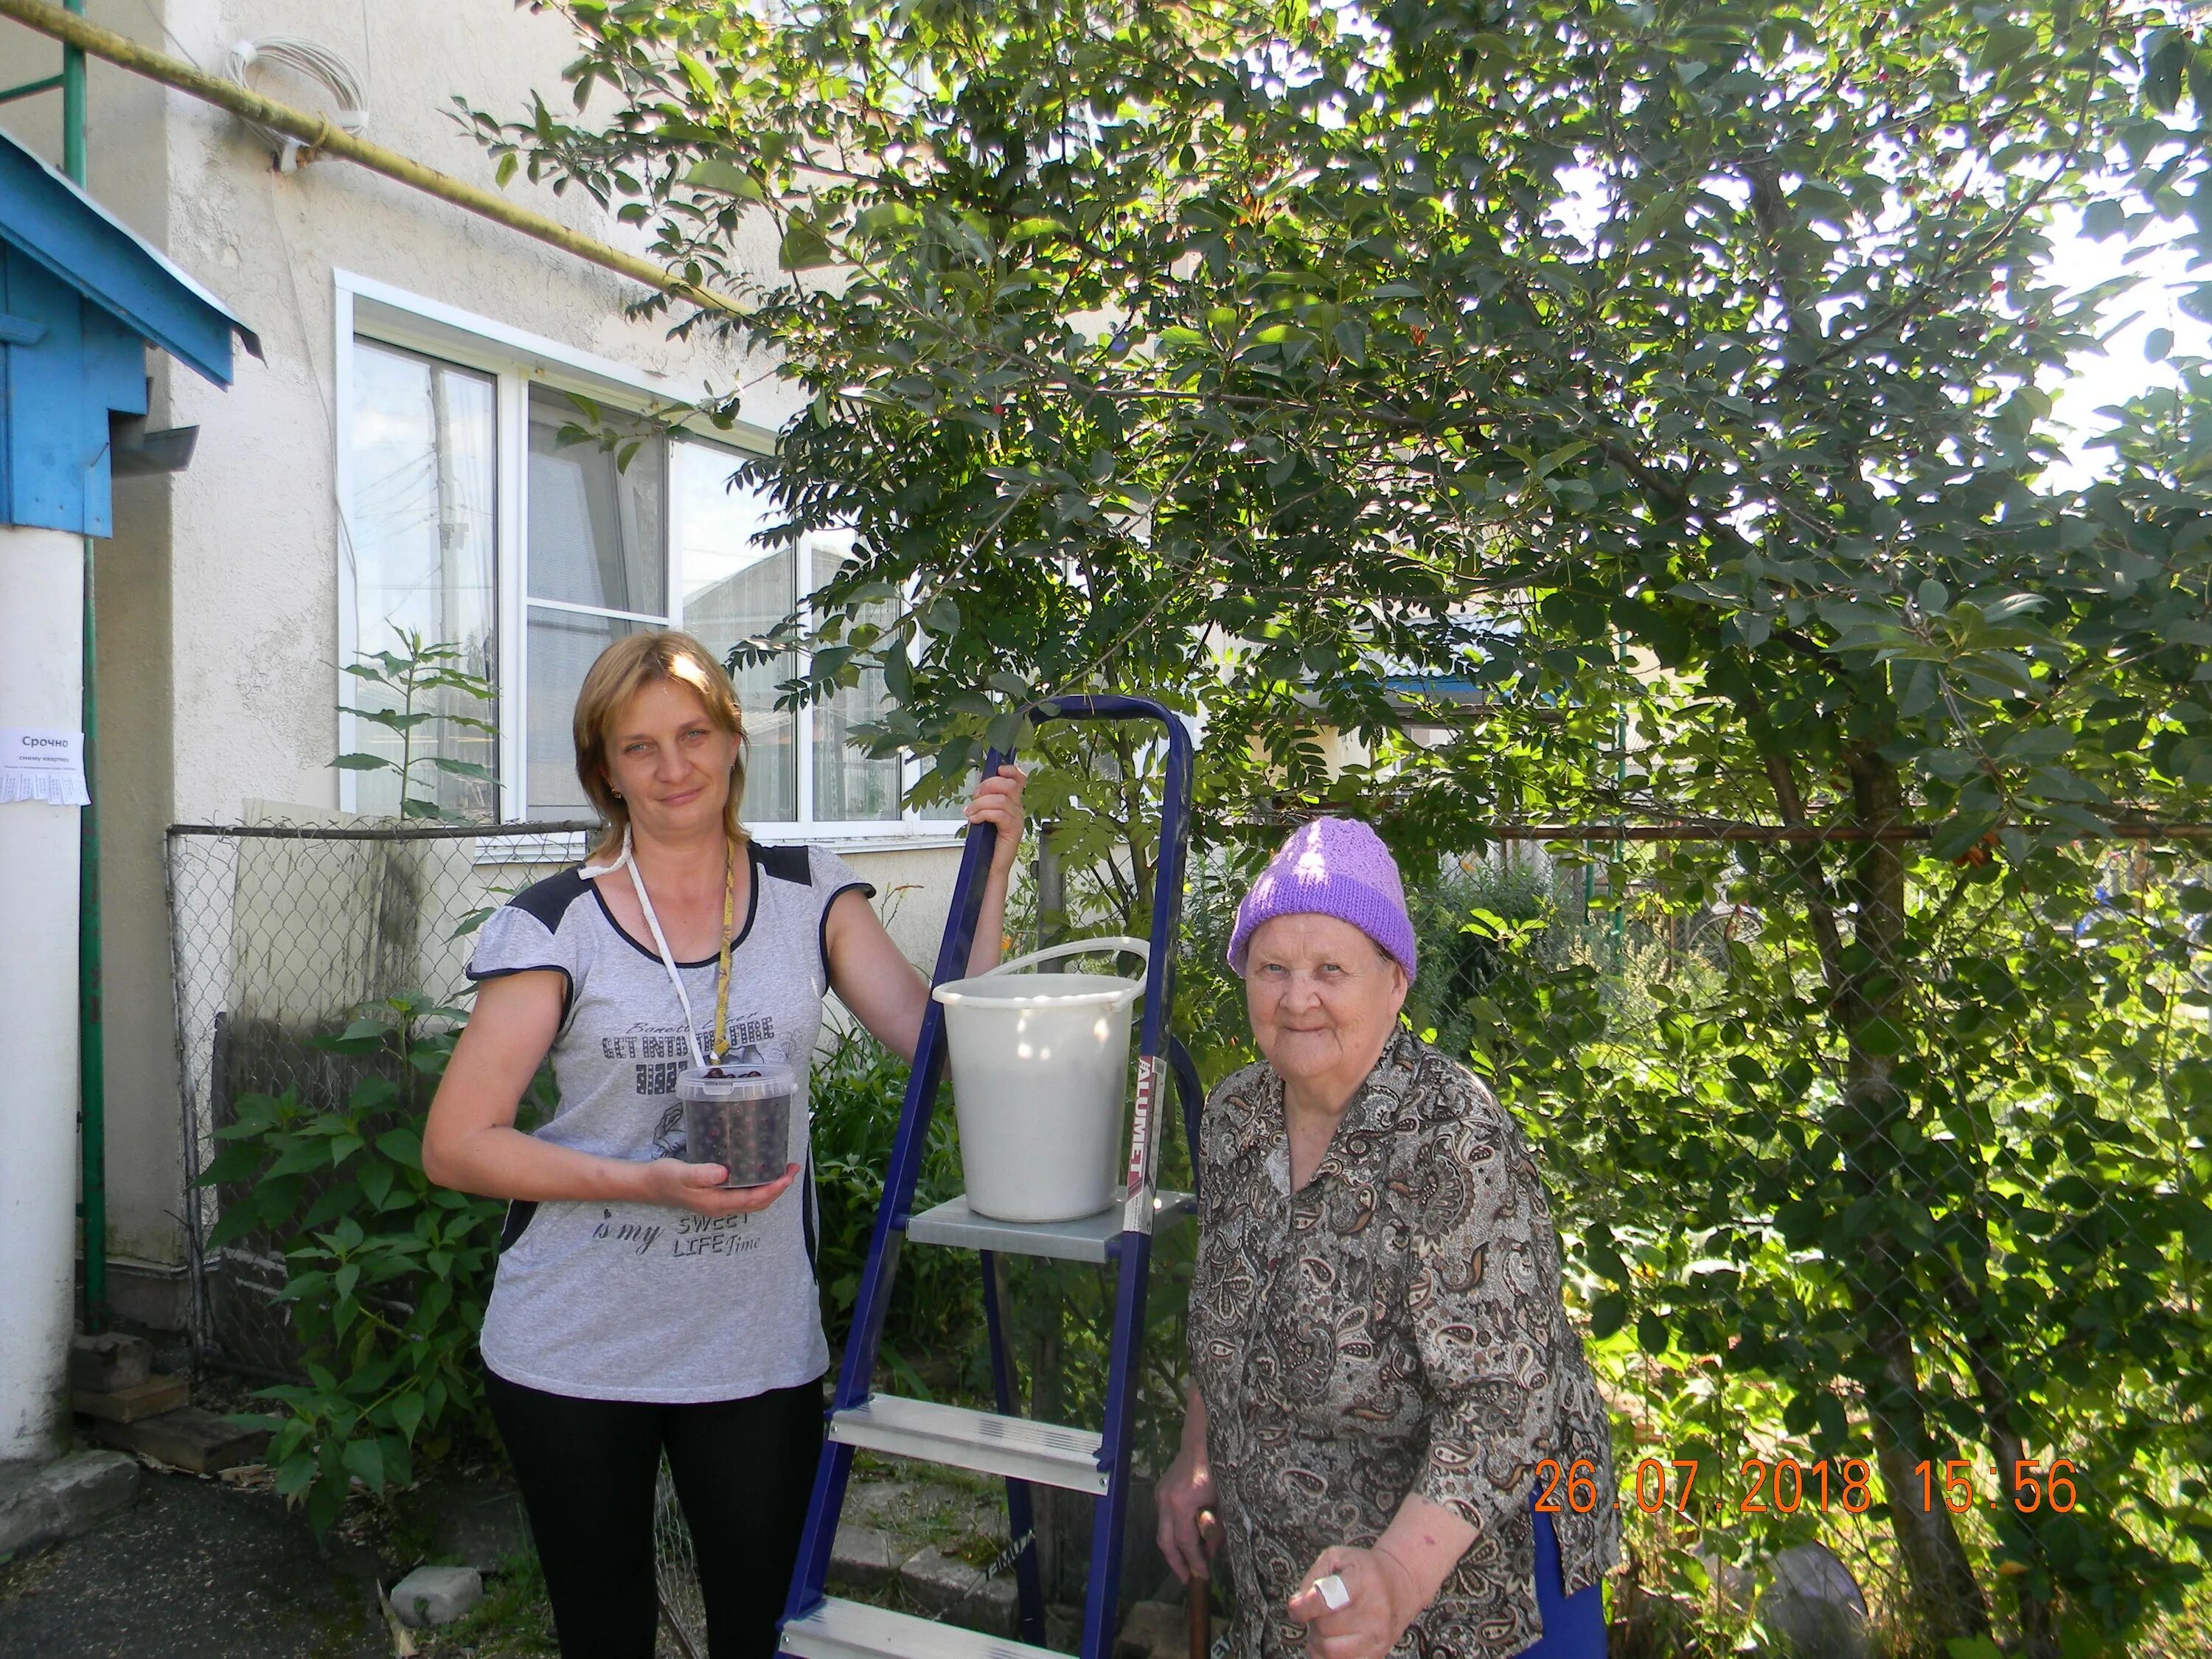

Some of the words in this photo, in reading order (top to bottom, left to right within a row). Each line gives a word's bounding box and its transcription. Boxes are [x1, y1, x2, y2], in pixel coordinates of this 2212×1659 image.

[22, 736, 69, 748] Срочно
[602, 1036, 638, 1059] GET
[642, 1035, 689, 1058] INTO
[729, 1016, 774, 1046] FIRE
[1130, 1060, 1150, 1178] ALUMET
[592, 1208, 613, 1239] is
[617, 1223, 666, 1256] my
